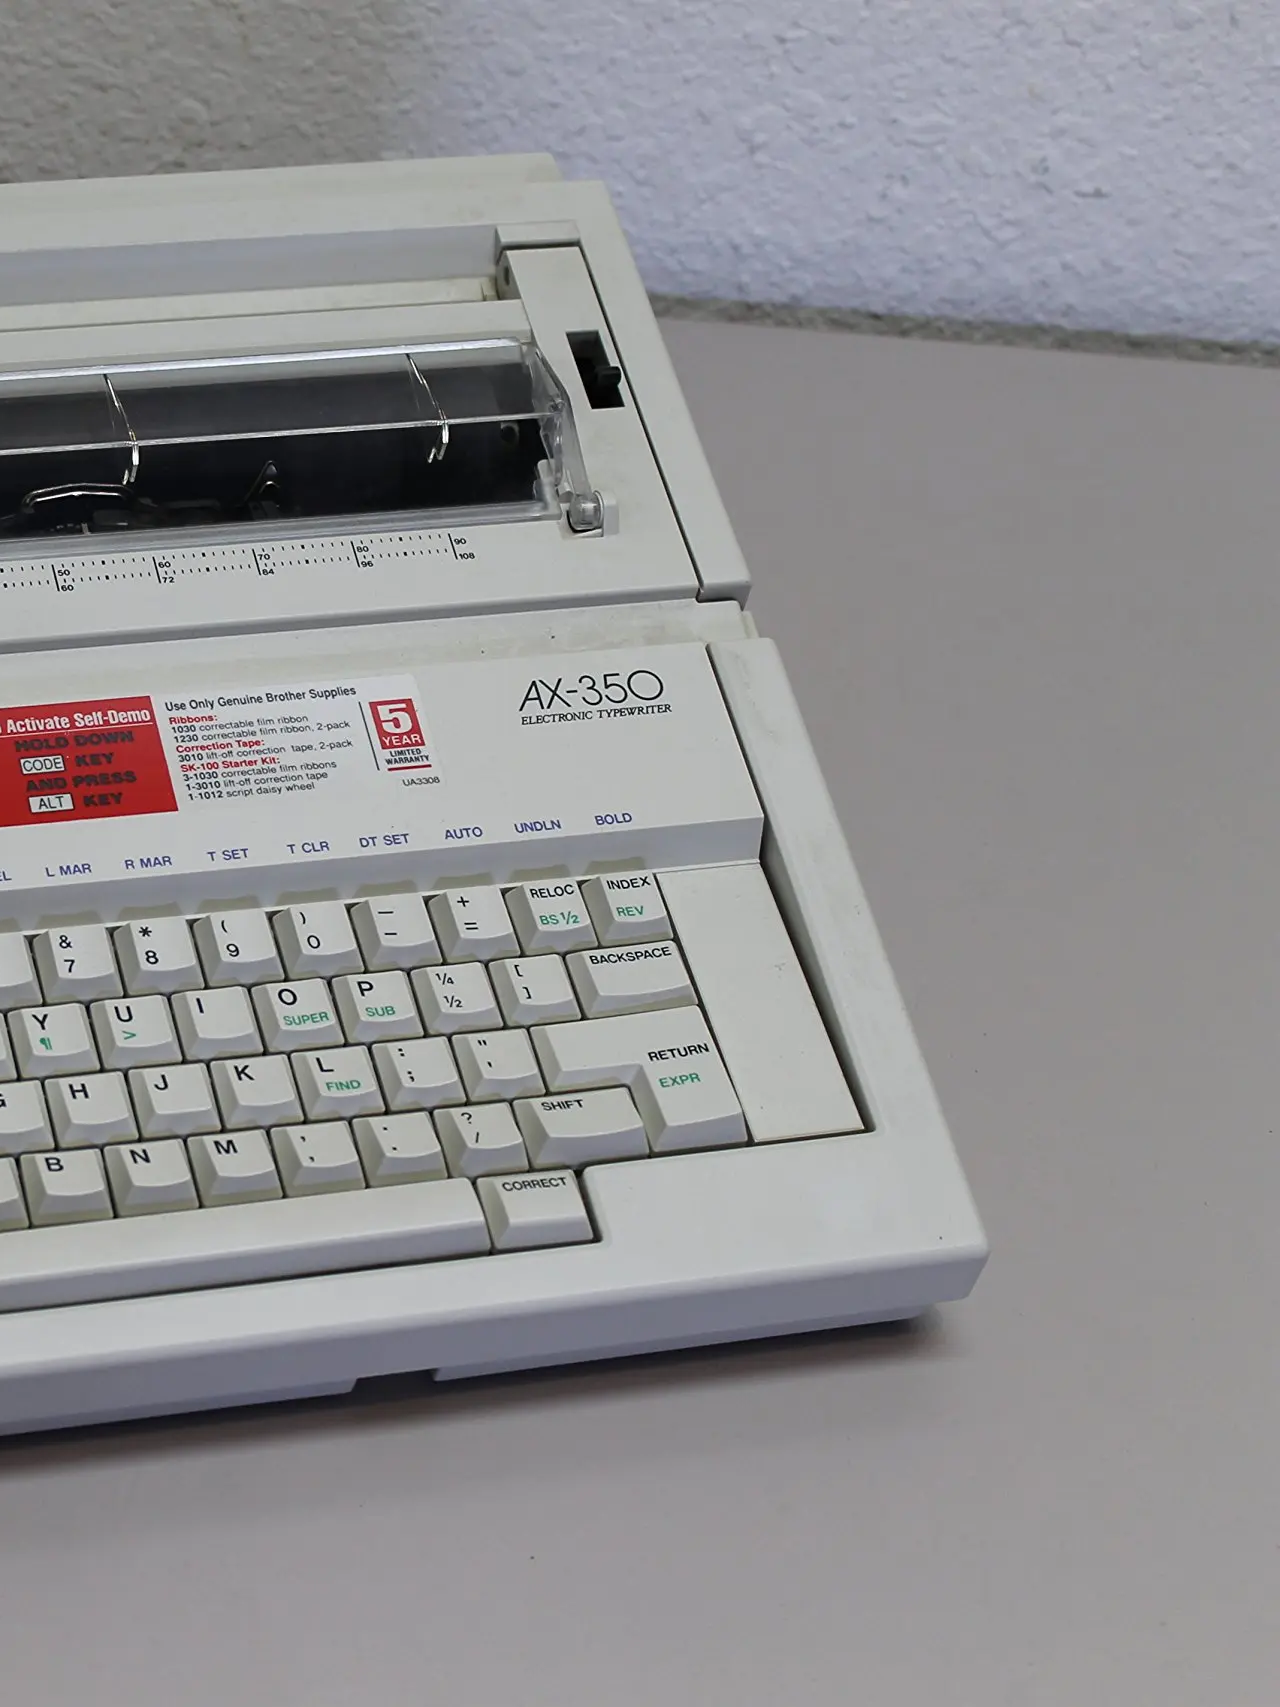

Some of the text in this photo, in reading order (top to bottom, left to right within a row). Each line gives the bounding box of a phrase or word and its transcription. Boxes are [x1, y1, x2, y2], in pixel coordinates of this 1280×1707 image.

[360, 560, 374, 568] 96
[519, 670, 664, 711] AX-350
[165, 686, 356, 712] Use Only Genuine Brother Supplies
[7, 713, 70, 733] Activate
[74, 708, 151, 728] Self-Demo
[376, 703, 413, 734] 5
[521, 704, 672, 725] ELECTRONIC TYPEWRITER
[171, 714, 309, 734] 1030 correctable film ribbon
[14, 731, 134, 753] HOLD DOWN
[176, 742, 233, 754] Correction
[381, 733, 421, 747] YEAR
[178, 753, 203, 762] 3010
[236, 745, 286, 758] correction
[320, 739, 353, 751] 2-pack
[389, 748, 421, 758] LIMITED
[22, 753, 115, 771] CODE KEY
[180, 762, 219, 773] SK-100
[222, 759, 258, 769] Starter
[385, 755, 430, 765] WARRANTY
[183, 760, 337, 782] 3-1030 correctable film ribbons
[26, 771, 137, 792] AND PRESS
[185, 780, 221, 791] 1-3010
[253, 773, 303, 785] correction
[306, 771, 328, 782] tape
[188, 782, 315, 801] 1-1012 script daisy wheel
[38, 792, 123, 809] ALT KEY
[514, 819, 562, 834] UNDLN
[594, 812, 633, 826] BOLD
[359, 833, 410, 849] DT SET
[444, 826, 483, 840] AUTO
[207, 848, 249, 862] T SET
[287, 841, 330, 855] T CLR
[45, 863, 92, 877] L MAR
[125, 855, 173, 870] R MAR
[529, 883, 575, 899] RELOC
[606, 875, 651, 891] INDEX
[540, 914, 559, 925] BS
[616, 905, 644, 918] REV
[145, 950, 159, 964] 8
[589, 946, 672, 965] BACKSPACE
[356, 981, 374, 997] P
[283, 1011, 329, 1026] SUPER
[365, 1005, 396, 1018] SUB
[32, 1013, 49, 1031] Y
[647, 1043, 710, 1062] RETURN
[316, 1057, 335, 1073] L
[326, 1079, 361, 1092] FIND
[659, 1072, 701, 1089] EXPR
[541, 1099, 584, 1112] SHIFT
[213, 1140, 239, 1155] M
[130, 1148, 151, 1164] N
[502, 1176, 567, 1192] CORRECT
